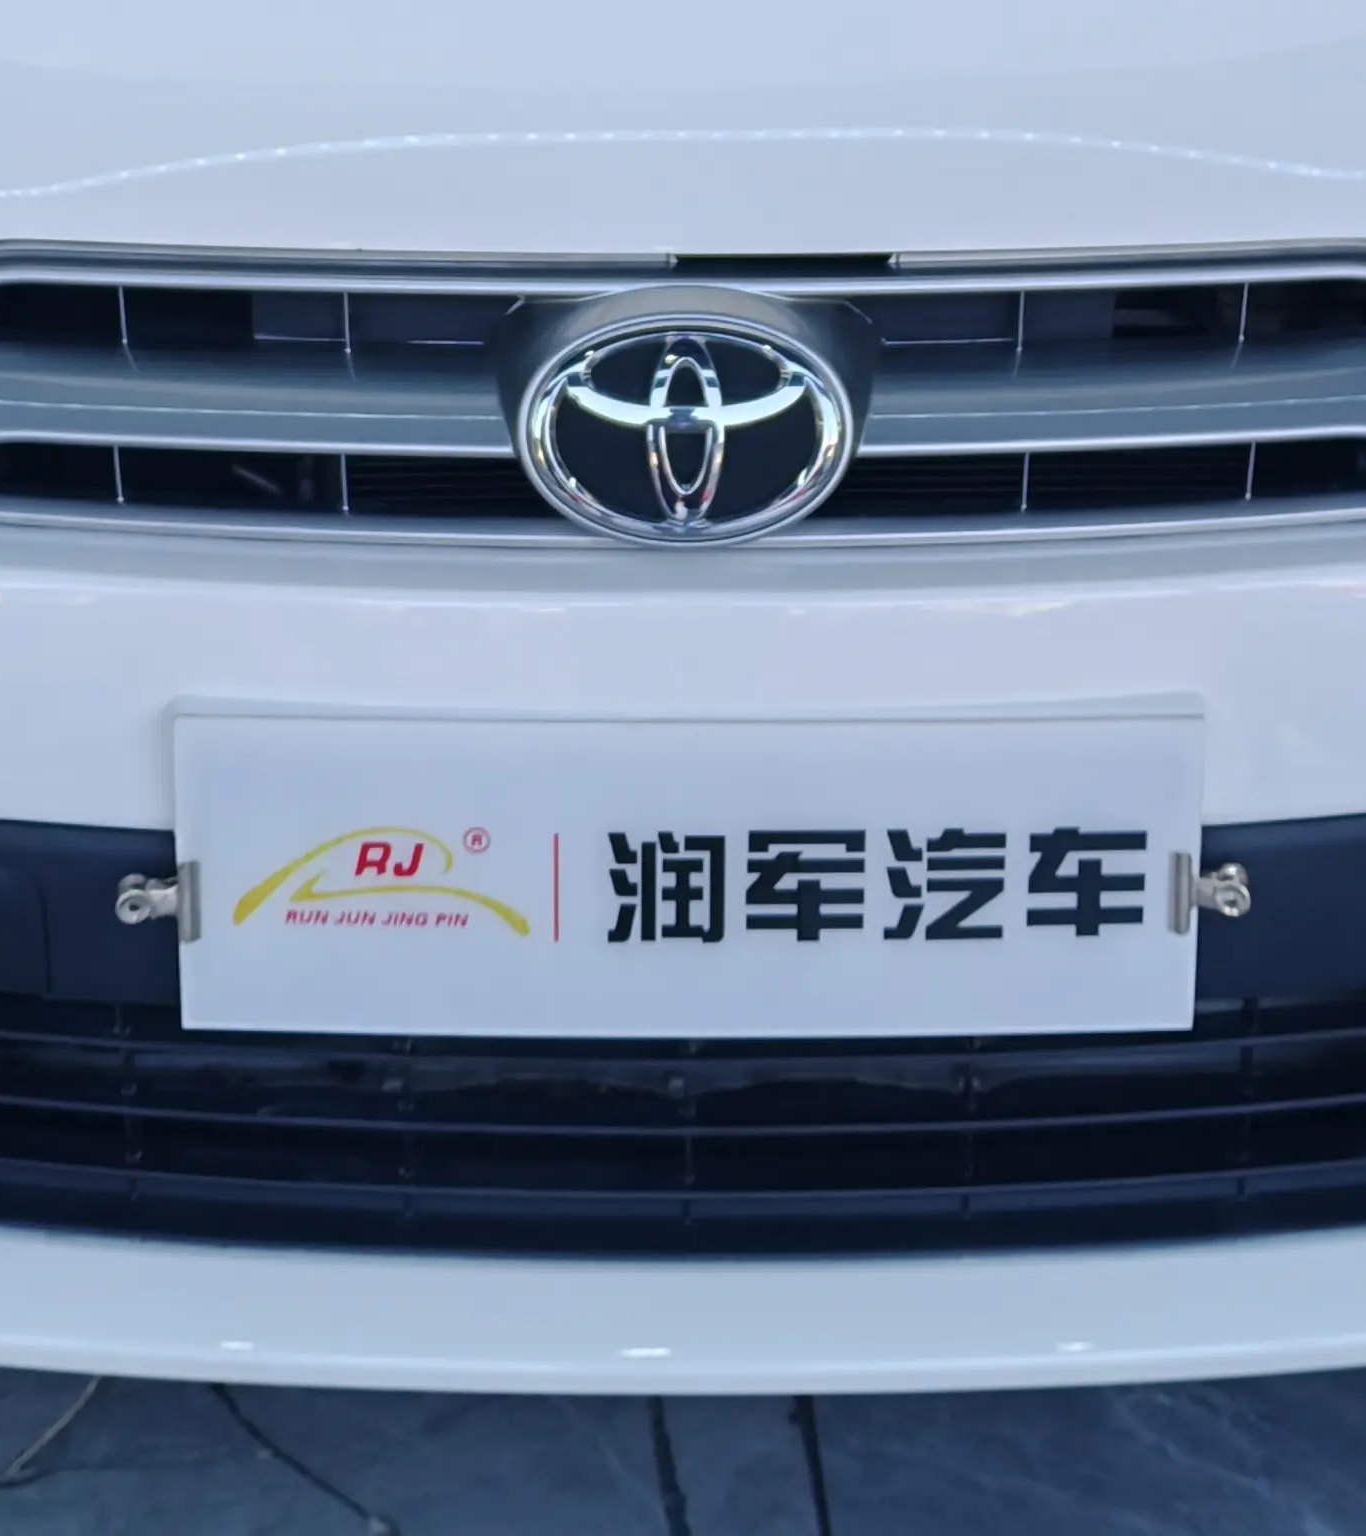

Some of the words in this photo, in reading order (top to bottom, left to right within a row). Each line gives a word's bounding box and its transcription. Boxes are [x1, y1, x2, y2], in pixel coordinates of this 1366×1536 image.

[354, 841, 425, 878] RJ
[606, 826, 1149, 944] 润军汽车
[284, 909, 328, 925] RUN
[333, 910, 376, 926] JUN
[381, 911, 427, 927] JING
[434, 912, 469, 928] PIN
